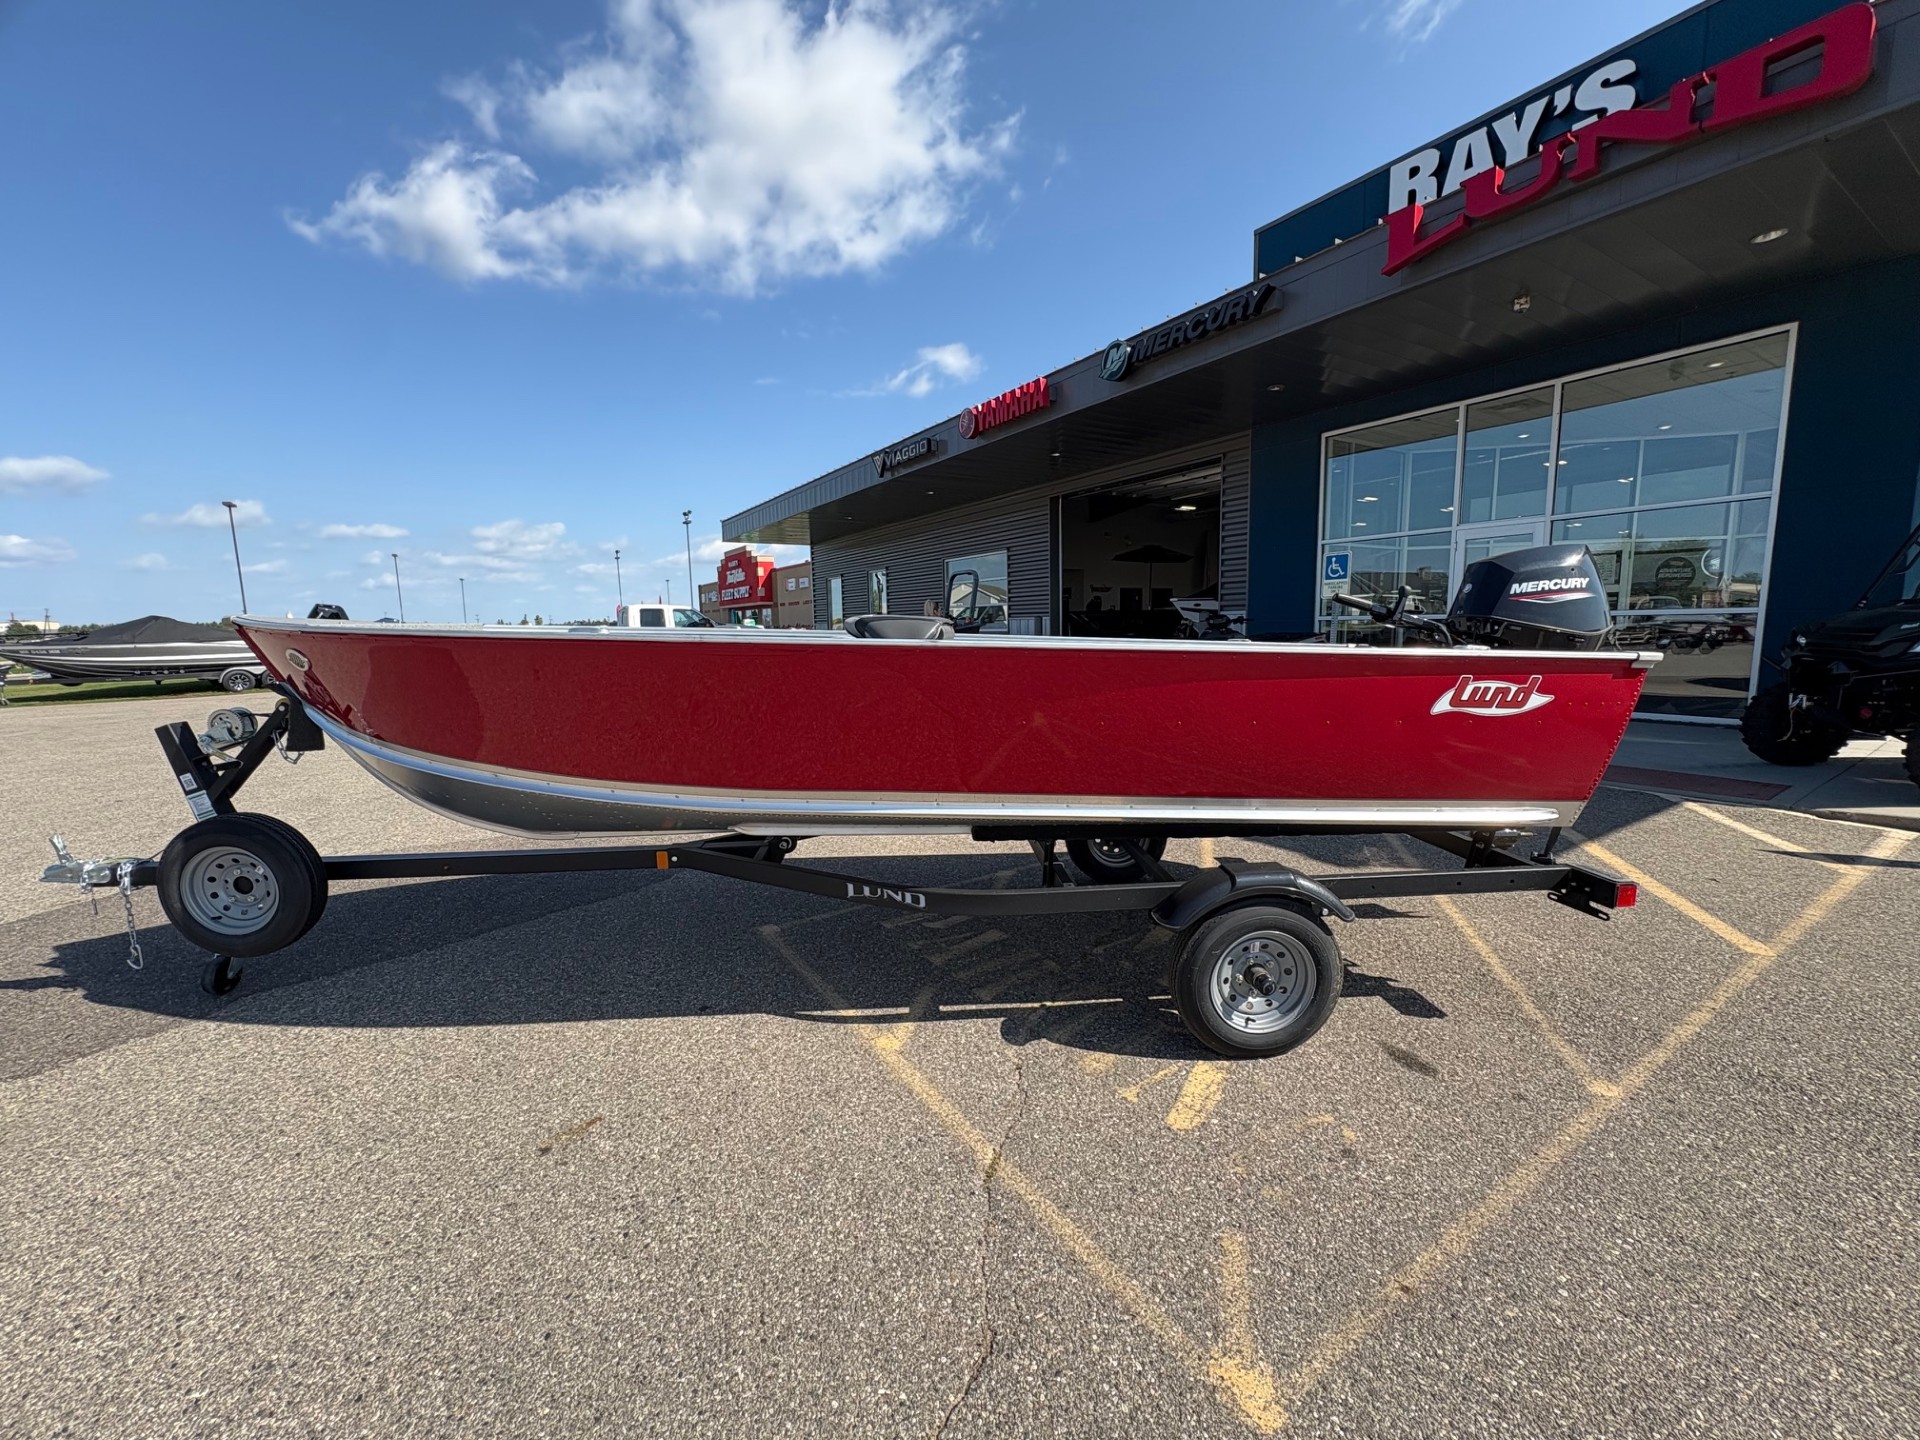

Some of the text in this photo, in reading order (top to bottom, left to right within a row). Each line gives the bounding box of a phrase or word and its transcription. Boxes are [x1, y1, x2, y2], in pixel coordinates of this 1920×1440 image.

[1381, 2, 1877, 277] LUND
[1388, 59, 1637, 214] RAY'S
[1131, 283, 1275, 363] MERCURY
[971, 376, 1049, 432] YAMAHA
[884, 440, 928, 469] VIAGGIO
[1509, 577, 1590, 594] MERCURY
[1448, 675, 1541, 709] Lund
[846, 882, 926, 908] LUND
